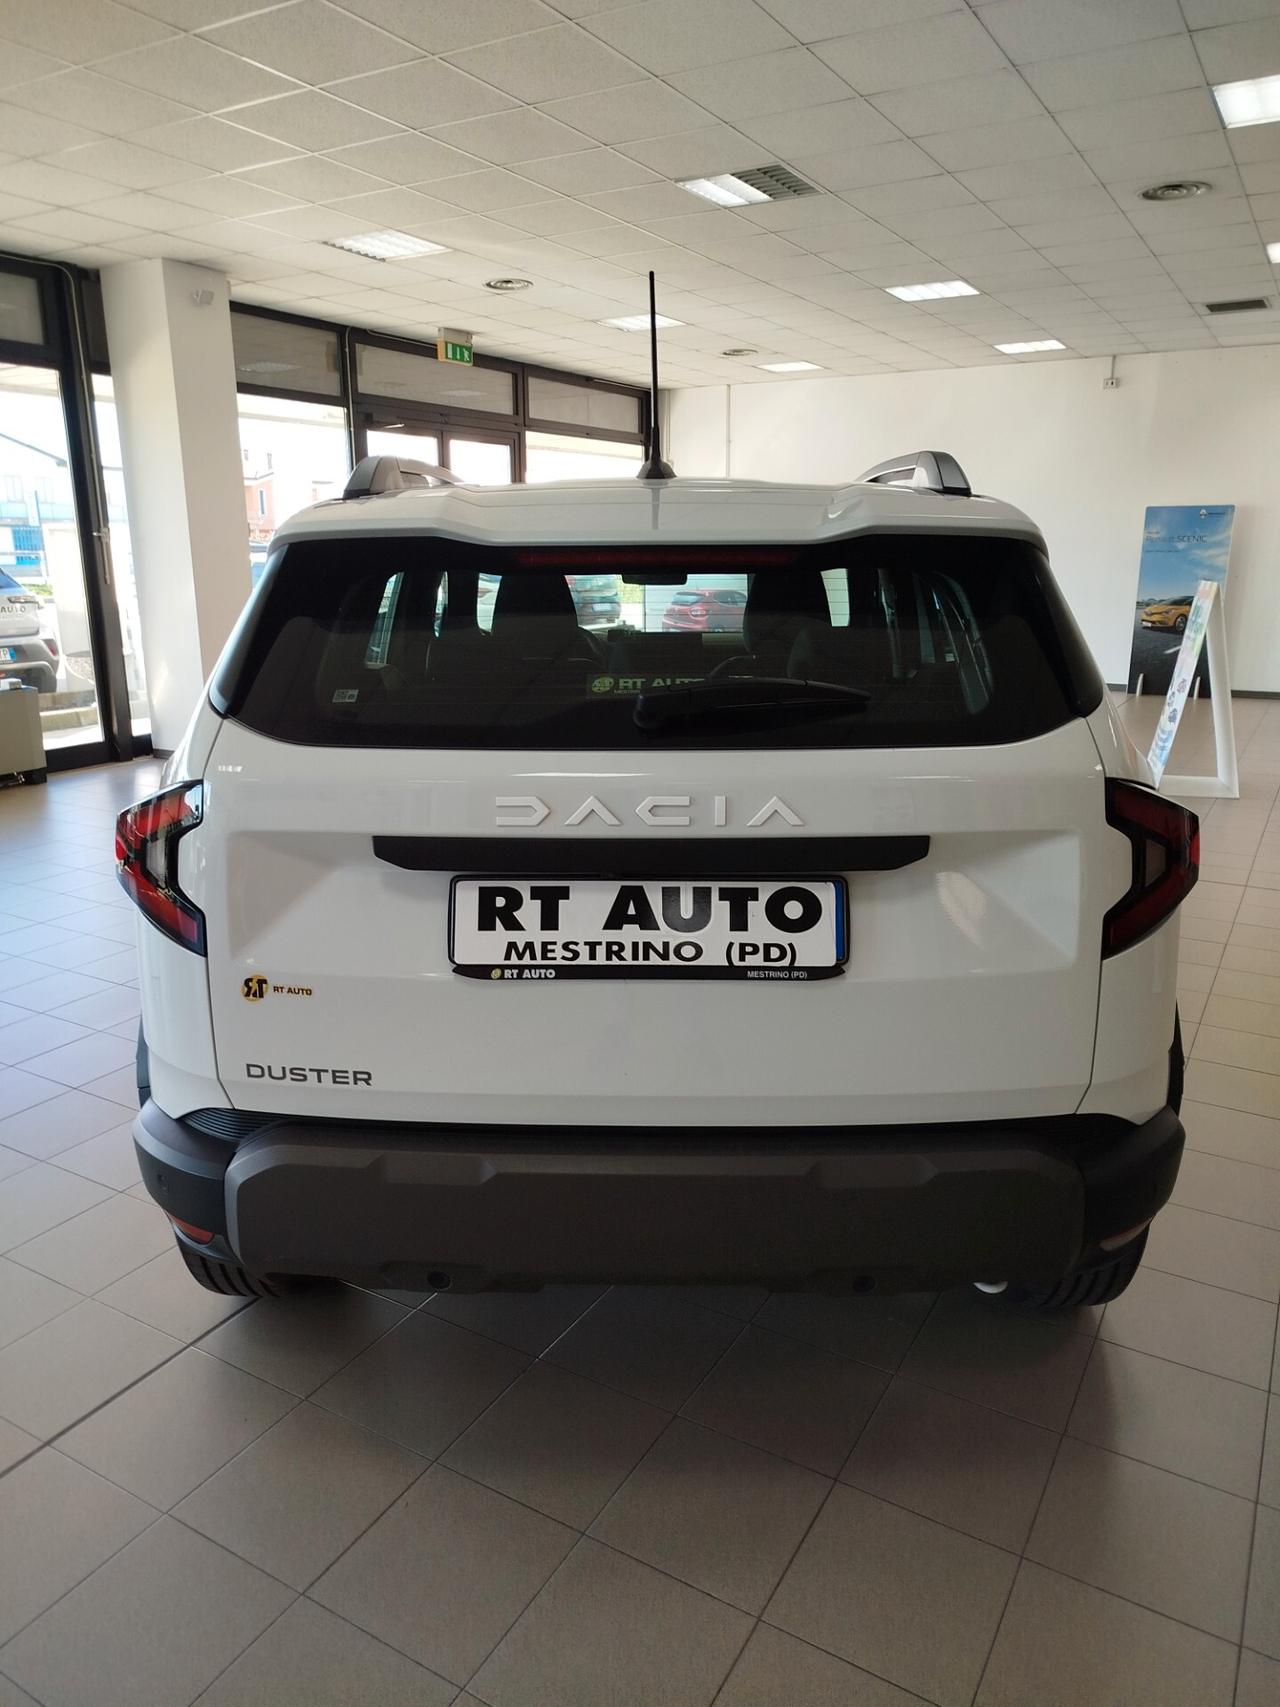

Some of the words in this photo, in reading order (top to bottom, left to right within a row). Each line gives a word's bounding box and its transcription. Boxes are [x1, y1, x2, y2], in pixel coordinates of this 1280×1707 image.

[618, 678, 646, 689] RT
[495, 794, 805, 827] DACIA
[477, 885, 570, 932] RT
[601, 884, 823, 934] AUTO
[502, 940, 704, 962] MESTRINO
[725, 941, 797, 967] (PD)
[503, 969, 520, 978] RT
[522, 969, 556, 978] AUTO
[747, 970, 789, 978] MESTRINO
[790, 970, 808, 979] (PD)
[273, 985, 284, 993] RT
[286, 987, 313, 996] AUTO
[245, 1063, 373, 1087] DUSTER
